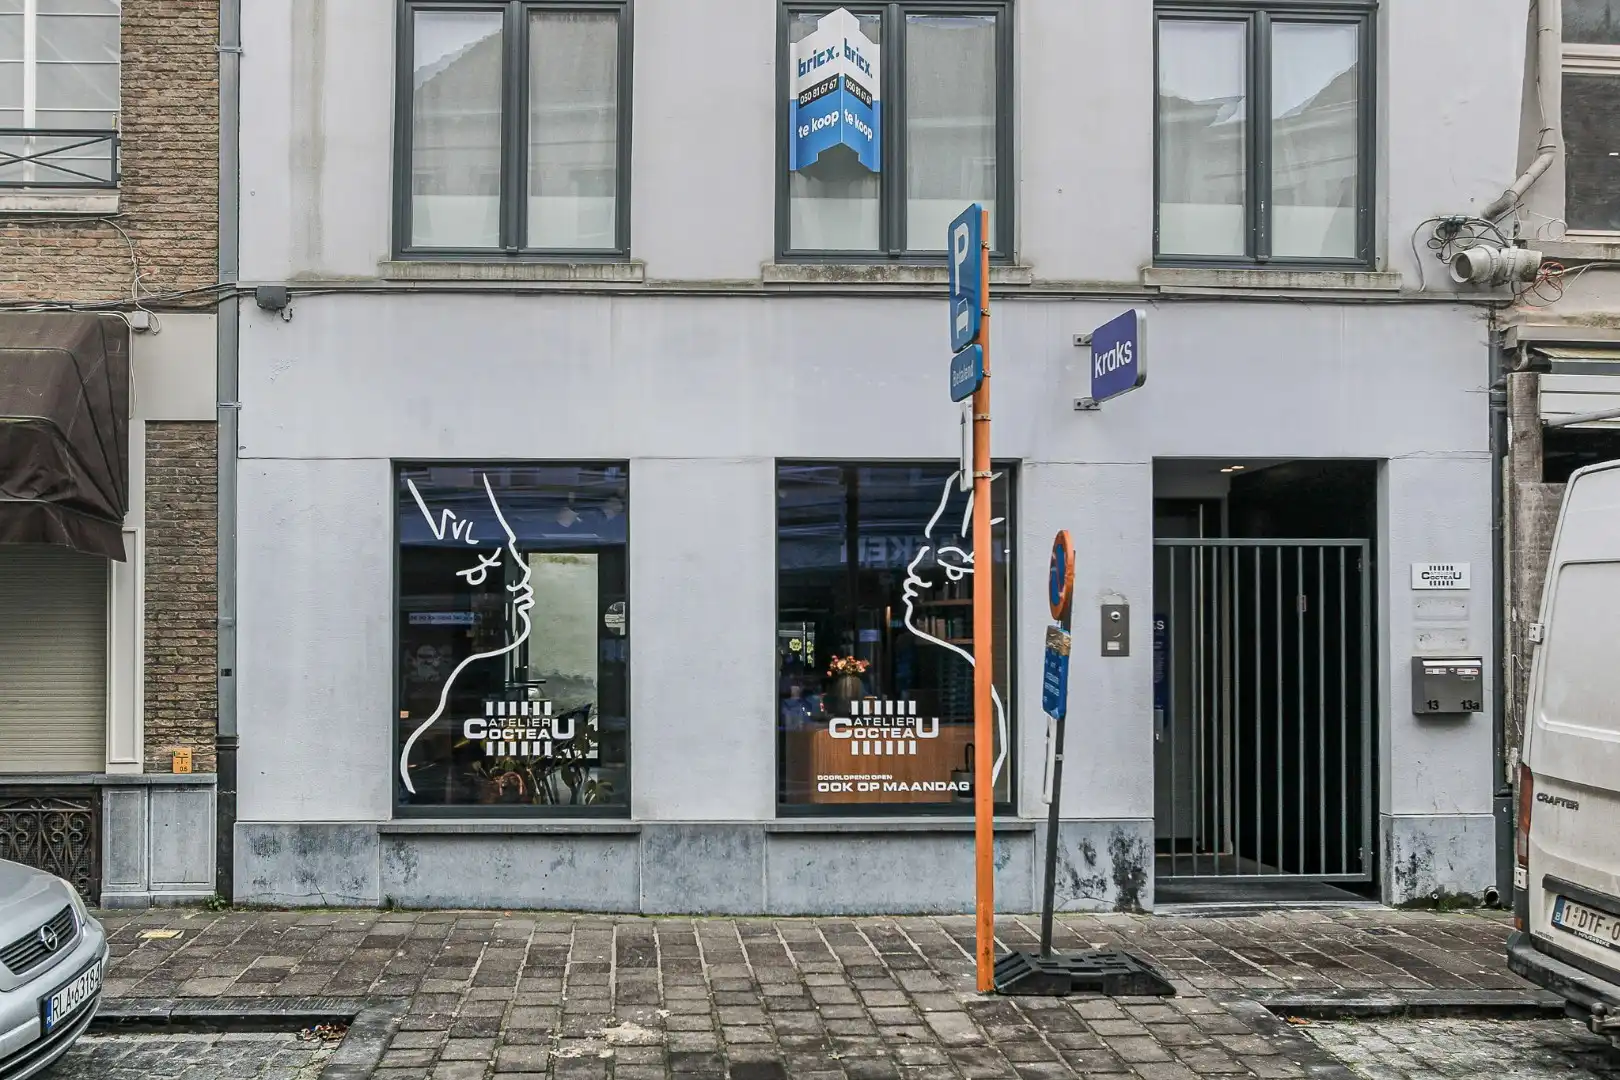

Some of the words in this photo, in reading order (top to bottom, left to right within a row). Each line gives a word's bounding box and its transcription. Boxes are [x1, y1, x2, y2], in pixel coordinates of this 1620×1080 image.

[800, 91, 812, 105] 050
[812, 87, 820, 98] 81
[820, 82, 828, 95] 67
[828, 78, 837, 91] 67
[798, 124, 809, 138] te
[811, 110, 840, 133] koop
[844, 108, 853, 126] te
[854, 113, 873, 141] koop
[953, 221, 969, 296] P
[1094, 340, 1133, 379] kraks
[1421, 571, 1462, 580] COCTEAU
[1426, 699, 1439, 711] 13
[1460, 699, 1480, 711] 13a
[463, 718, 575, 740] COCTEAU
[487, 718, 551, 728] ATELIER
[828, 717, 939, 739] COCTEAU
[853, 717, 915, 727] ATELIER
[817, 782, 853, 792] OOK
[857, 782, 880, 792] OP
[883, 781, 970, 792] MAANDAG
[1536, 792, 1580, 811] CRAFTER
[1555, 912, 1561, 921] B
